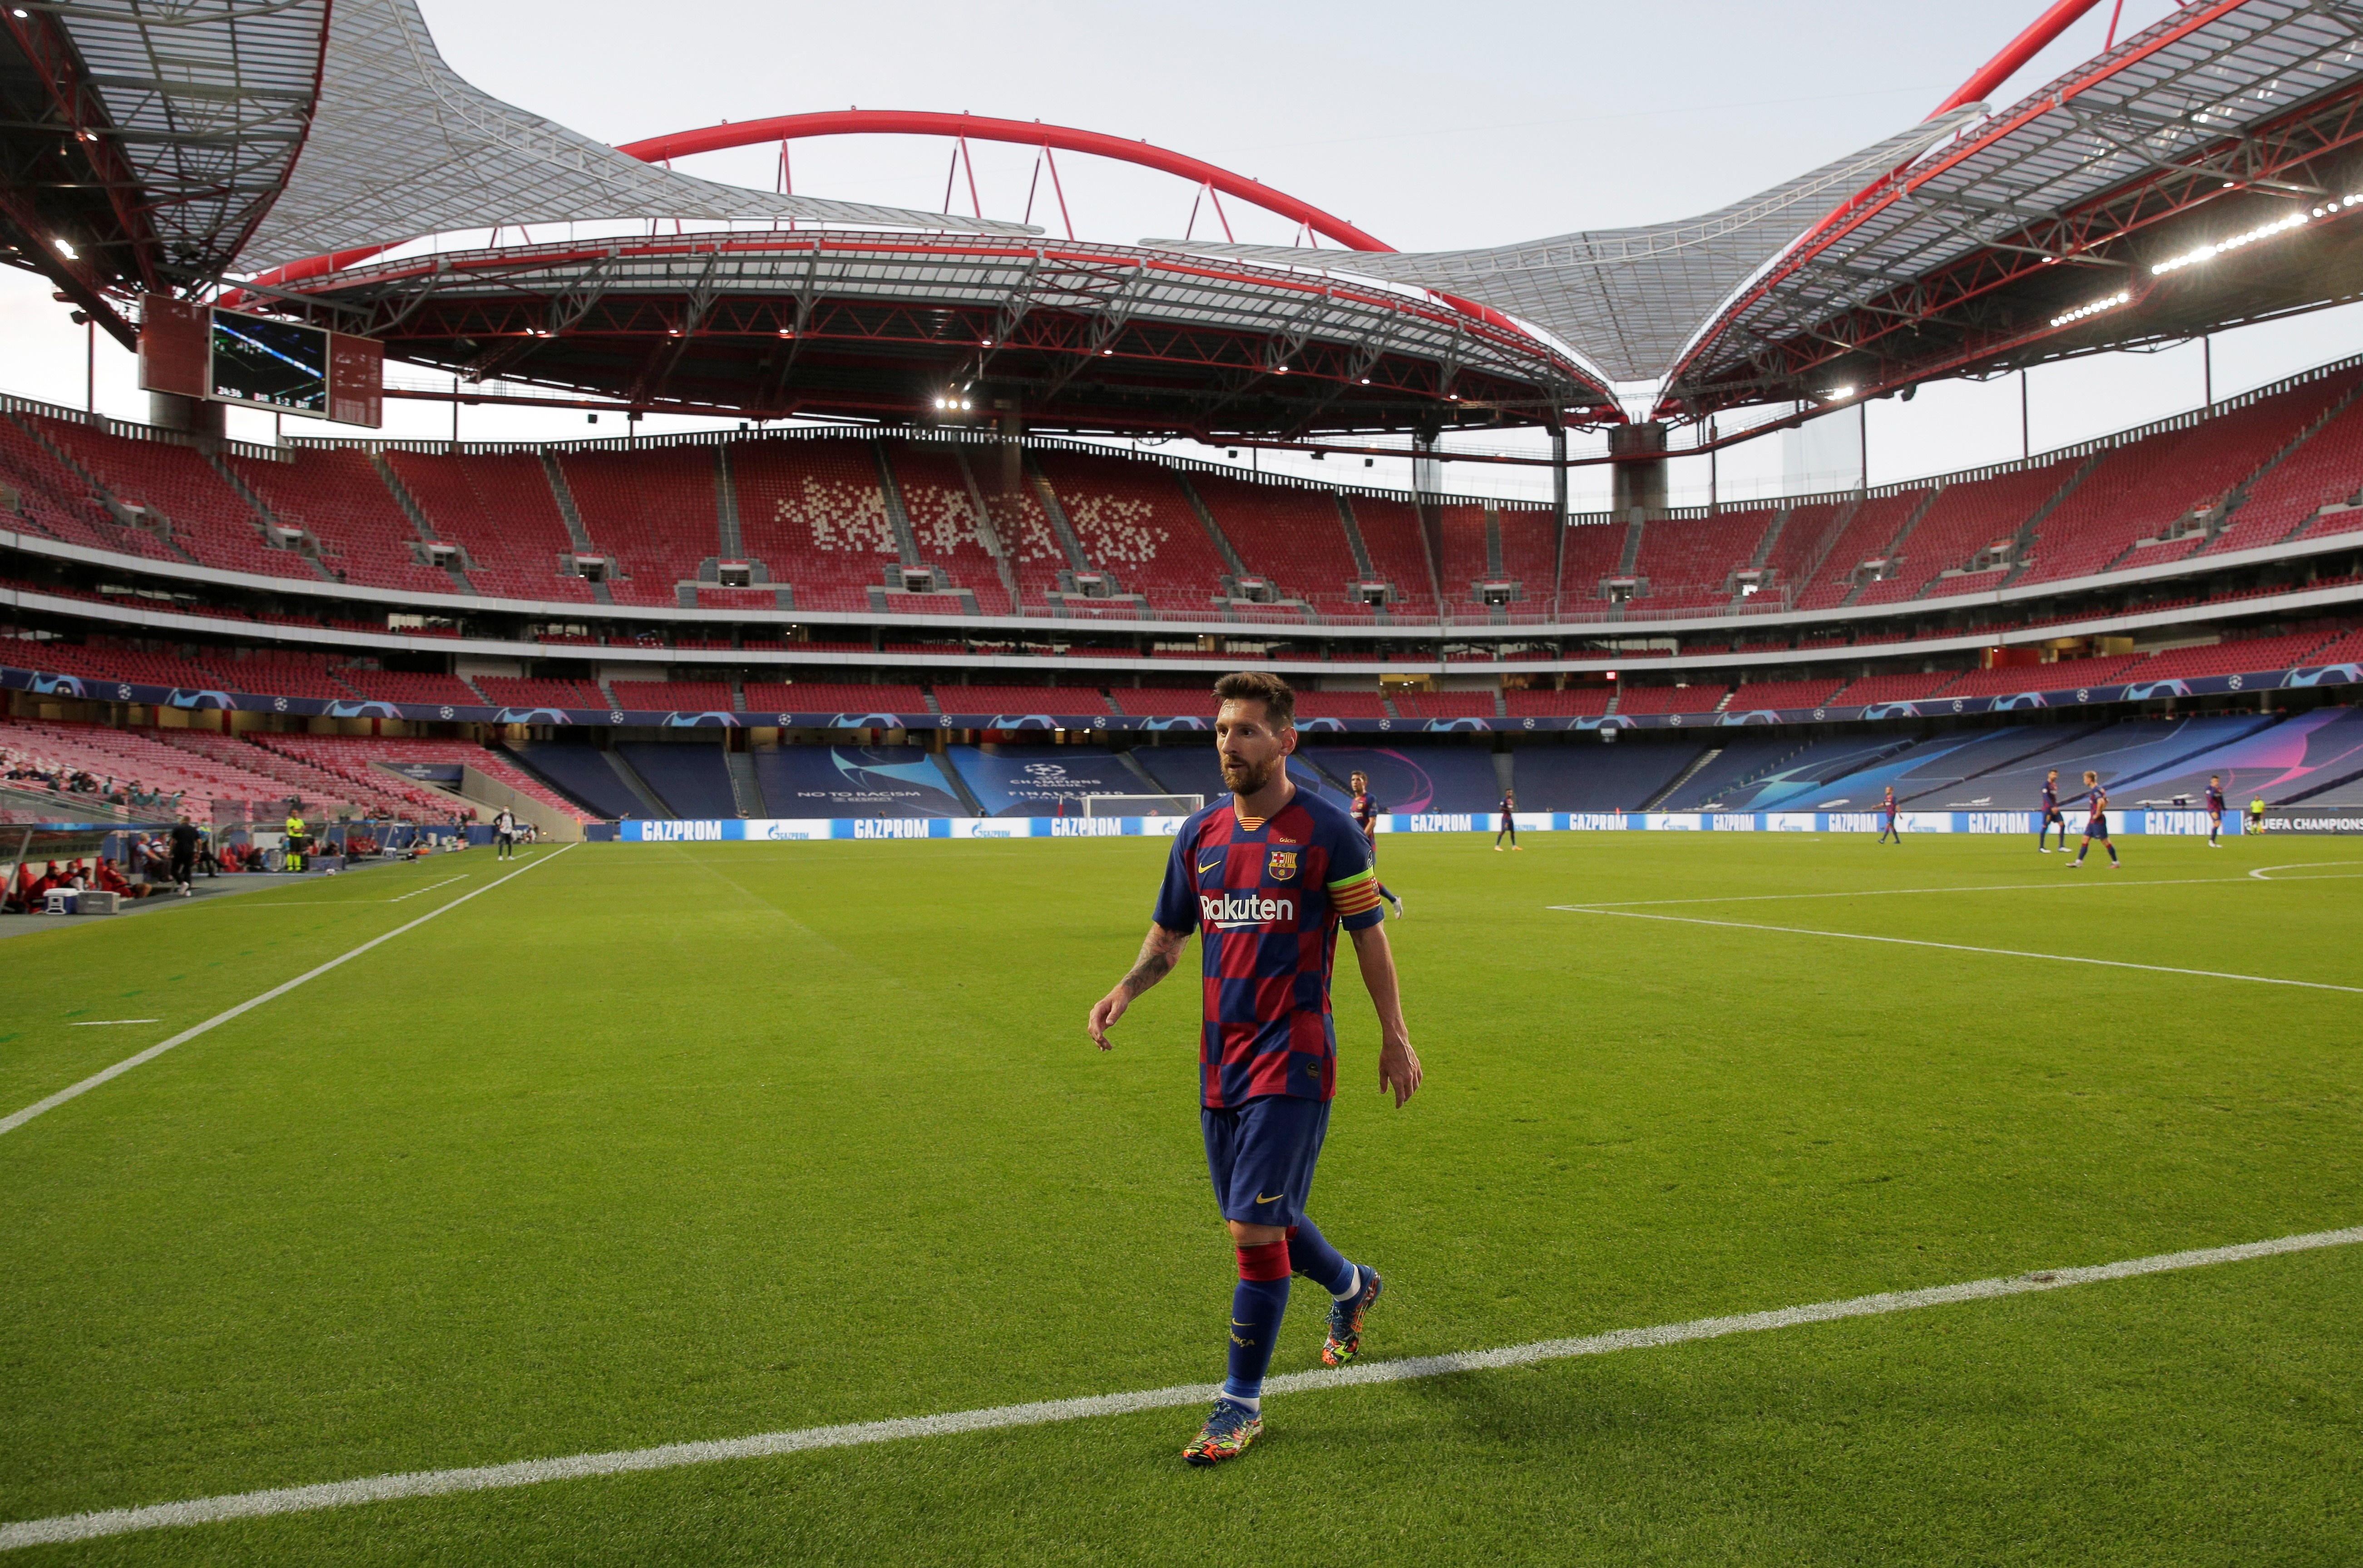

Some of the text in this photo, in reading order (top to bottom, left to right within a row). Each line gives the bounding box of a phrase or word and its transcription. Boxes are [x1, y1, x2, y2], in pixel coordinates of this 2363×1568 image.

[642, 821, 722, 841] GAZPROM
[854, 819, 929, 839] GAZPROM
[1051, 818, 1122, 836] GAZPROM
[1410, 814, 1471, 832] GAZPROM
[1569, 813, 1628, 831] GAZPROM
[1828, 813, 1877, 832] GAZPROM
[1968, 812, 2030, 834] GAZPROM
[2261, 818, 2292, 830] UEFA
[1200, 893, 1293, 920] Rakuten
